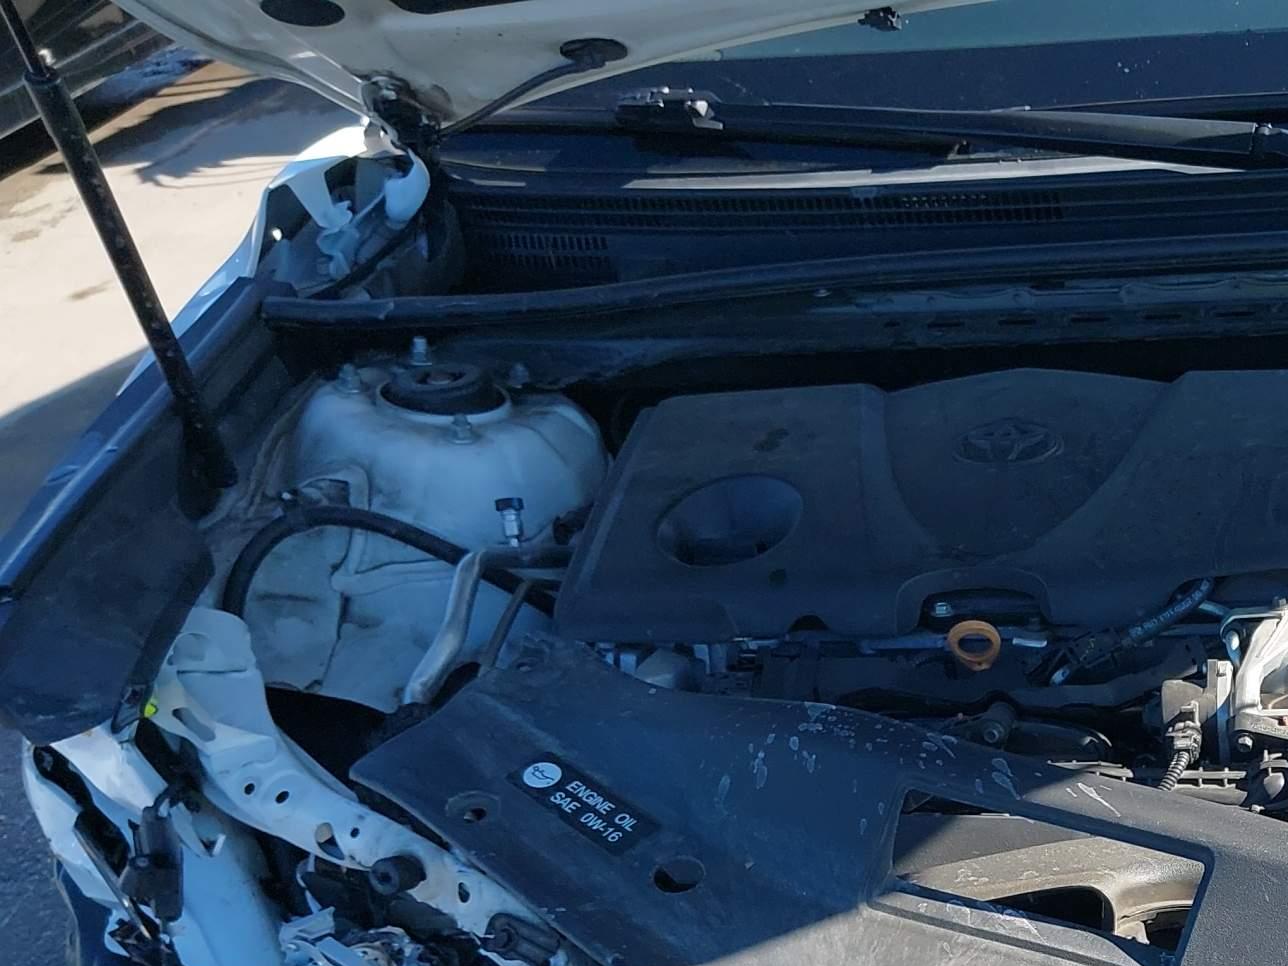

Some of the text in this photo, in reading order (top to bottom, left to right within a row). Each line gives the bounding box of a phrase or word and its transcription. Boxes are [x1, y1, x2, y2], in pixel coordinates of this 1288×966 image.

[550, 792, 623, 842] SAE 0W-16
[566, 781, 637, 832] ENGINE OIL
